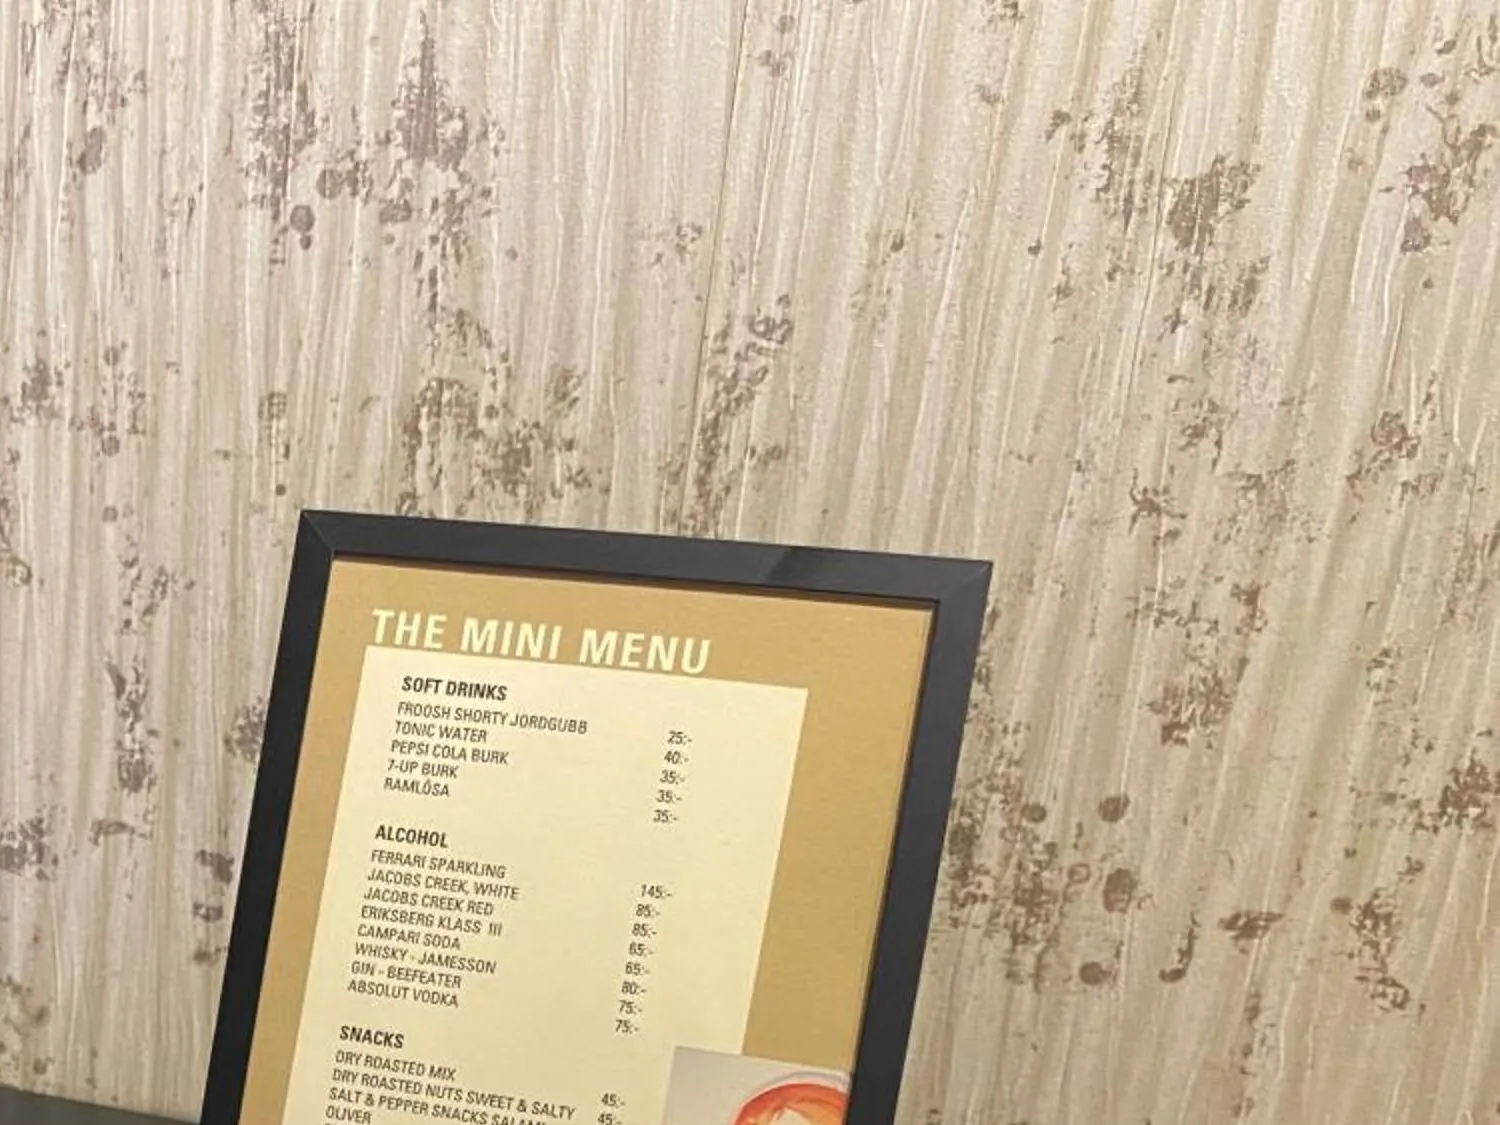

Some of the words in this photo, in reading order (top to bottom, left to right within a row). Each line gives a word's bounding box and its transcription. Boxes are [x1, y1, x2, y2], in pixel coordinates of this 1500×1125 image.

[372, 609, 448, 650] THE
[460, 618, 561, 660] MINI
[580, 629, 711, 674] MENU
[402, 676, 443, 694] SOFT
[446, 680, 507, 701] DRINKS
[396, 720, 436, 738] TONIC
[439, 725, 487, 743] WATER
[398, 702, 451, 720] FROOSH
[454, 707, 508, 725] SHORTY
[509, 713, 587, 734] JORDGUBB
[391, 739, 430, 756] PEPSI
[432, 744, 467, 761] COLA
[471, 748, 509, 764] BURK
[388, 759, 418, 774] 7-UP
[421, 762, 459, 779] BURK
[375, 825, 447, 848] ALCOHOL
[371, 849, 426, 868] FERRARI
[428, 857, 506, 878] SPARKLING
[368, 868, 422, 887] JACOBS
[474, 882, 519, 900] WHITE
[364, 887, 418, 906] JACOBS
[422, 894, 465, 912] CREEK
[466, 900, 494, 916] RED
[361, 905, 434, 928] ERIKSBERG
[438, 916, 482, 934] KLASS
[358, 924, 421, 944] CAMPARI
[423, 933, 460, 950] SODA
[356, 942, 408, 961] WHISKY
[418, 952, 496, 974] JAMESSON
[351, 960, 375, 976] GIN
[387, 965, 462, 988] BEEFEATER
[347, 979, 410, 999] ABSOLUT
[413, 988, 458, 1008] VODKA
[340, 1026, 404, 1048] SNACKS
[336, 1050, 362, 1066] DRY
[364, 1054, 426, 1076] ROASTED
[428, 1065, 456, 1081] MIX
[329, 1087, 363, 1104] SALT
[364, 1093, 375, 1106] &
[378, 1095, 429, 1116] PEPPER
[432, 1104, 488, 1125] SNACKS
[332, 1068, 359, 1085] DRY
[361, 1073, 423, 1095] ROASTED
[425, 1083, 463, 1102] NUTS
[465, 1090, 514, 1110] SWEET
[516, 1099, 527, 1112] &
[531, 1101, 575, 1120] SALTY
[326, 1105, 372, 1125] OLIVER
